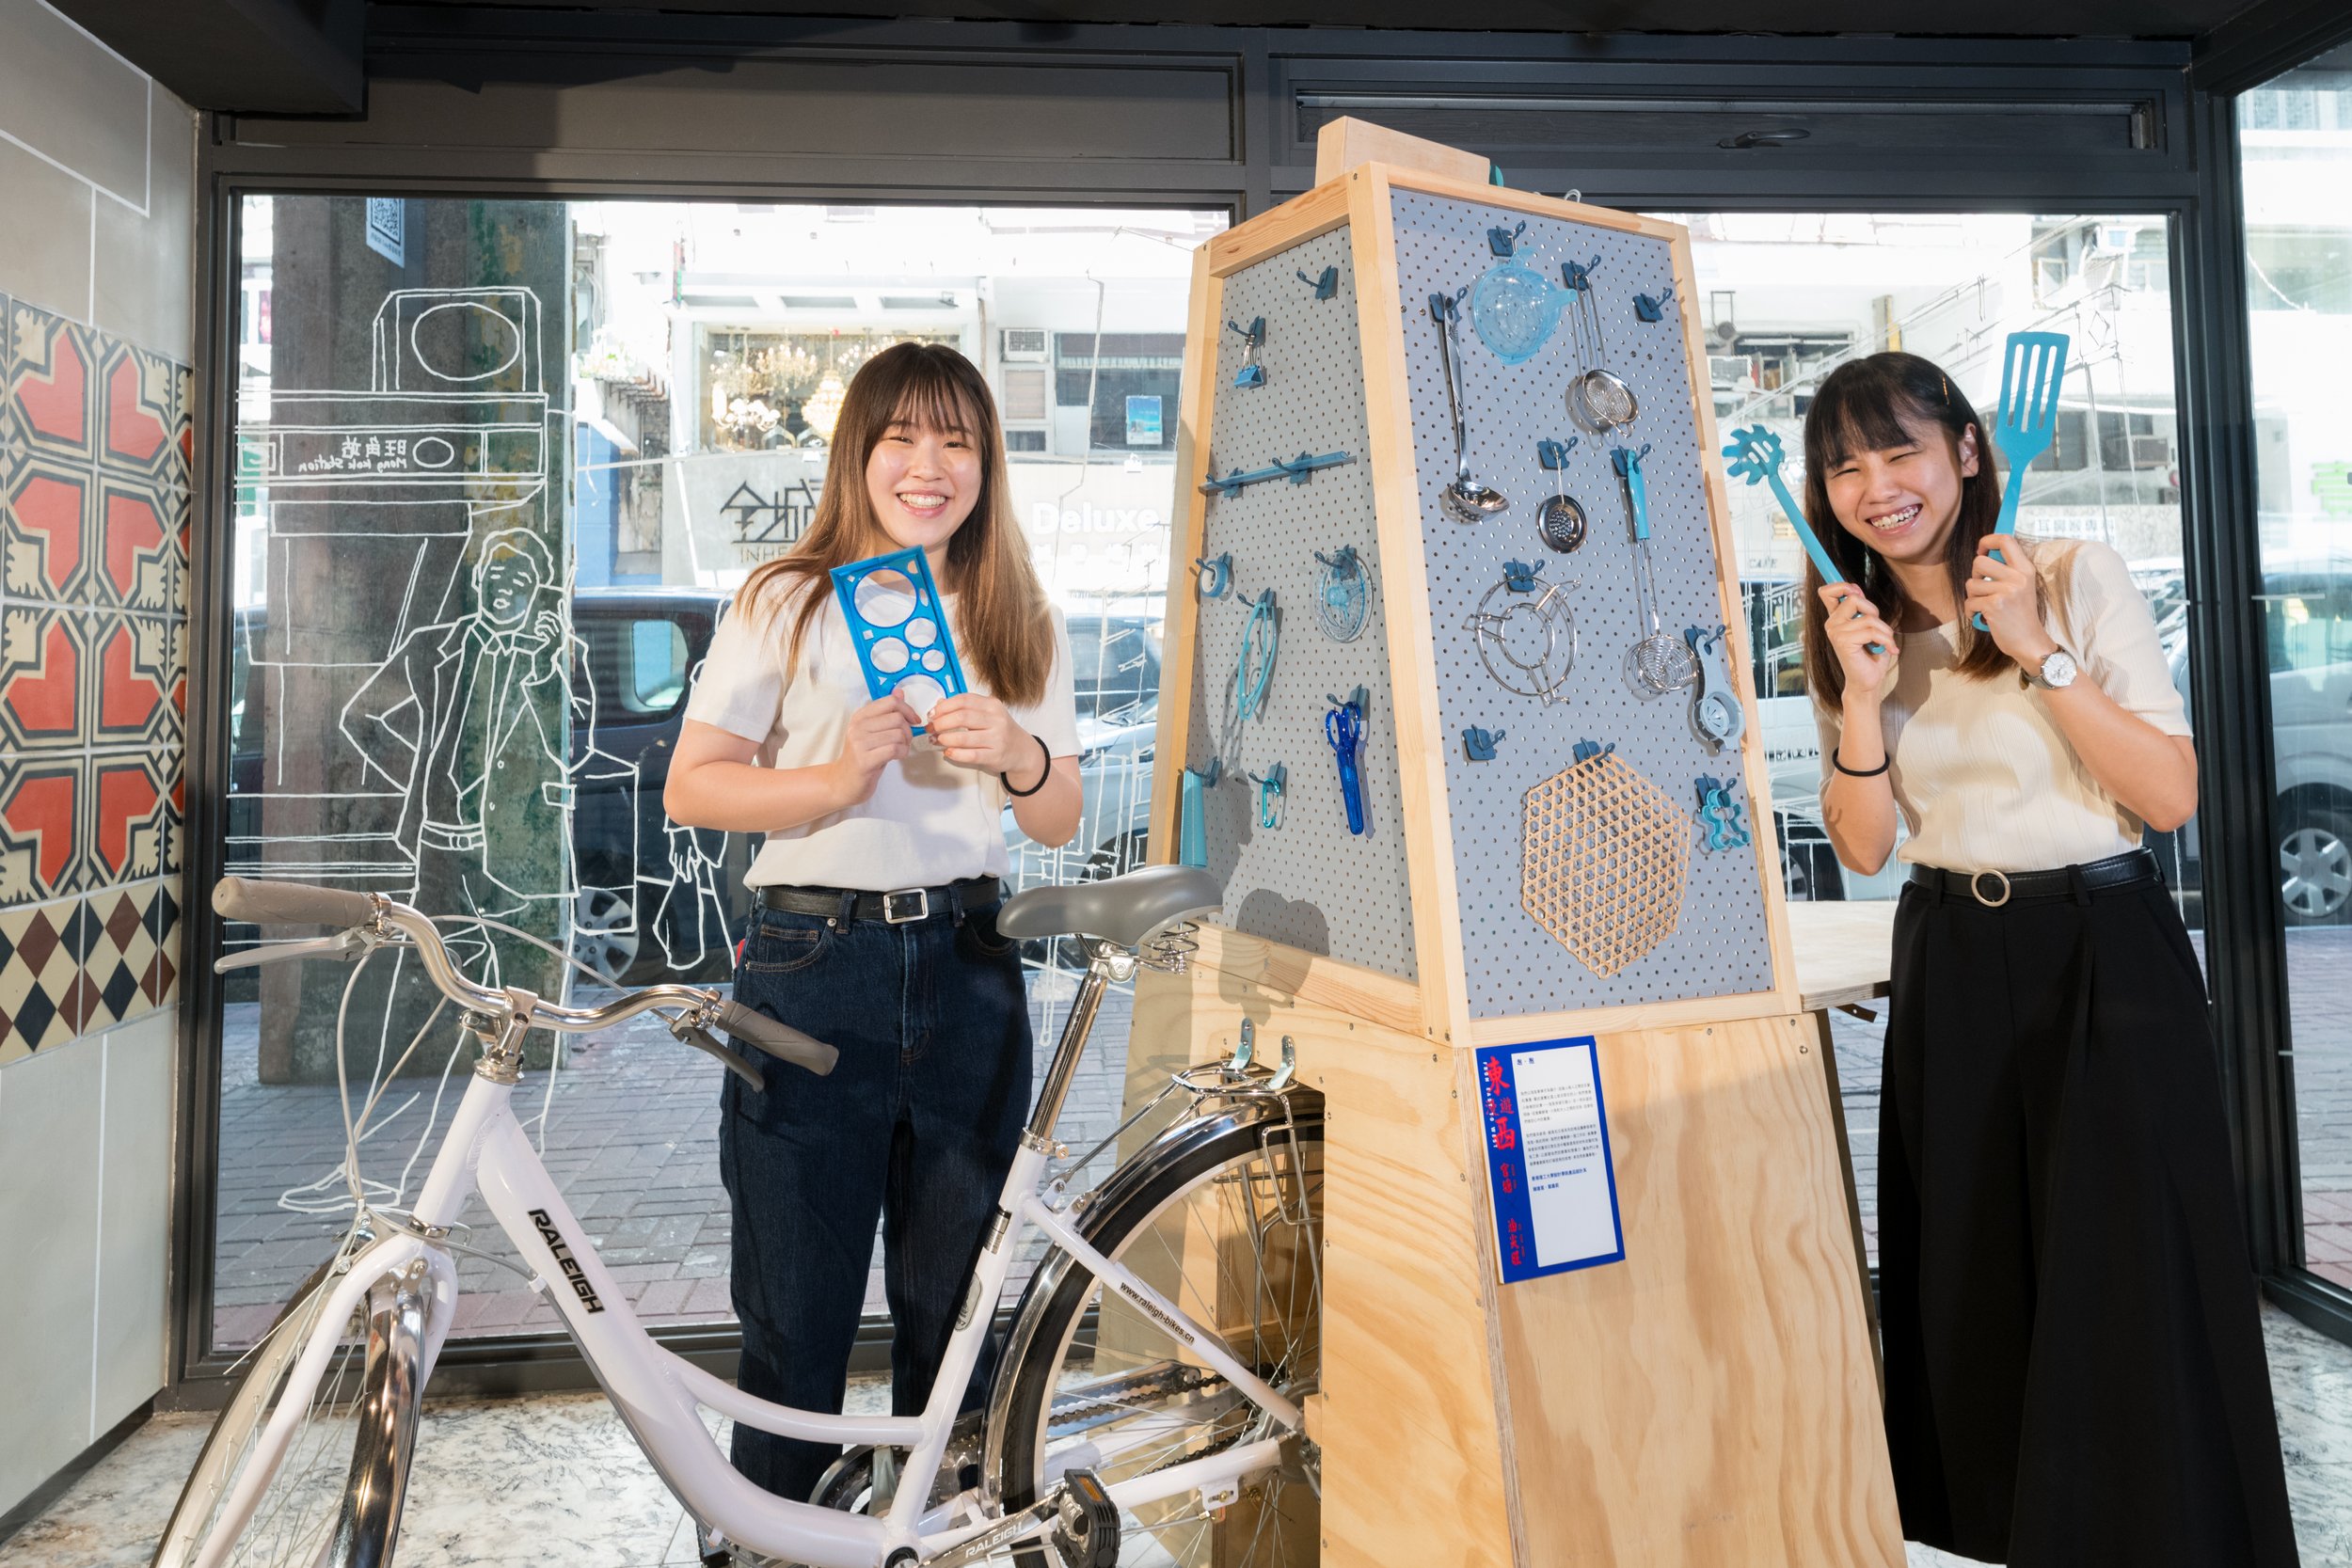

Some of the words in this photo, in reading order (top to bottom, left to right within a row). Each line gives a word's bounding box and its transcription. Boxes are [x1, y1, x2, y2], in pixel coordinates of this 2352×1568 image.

[1032, 500, 1159, 534] Deluxe
[527, 1209, 605, 1314] RALEIGH
[1120, 1282, 1195, 1344] www.raleigh-bikes.cn
[965, 1522, 1025, 1559] RALEIGH
